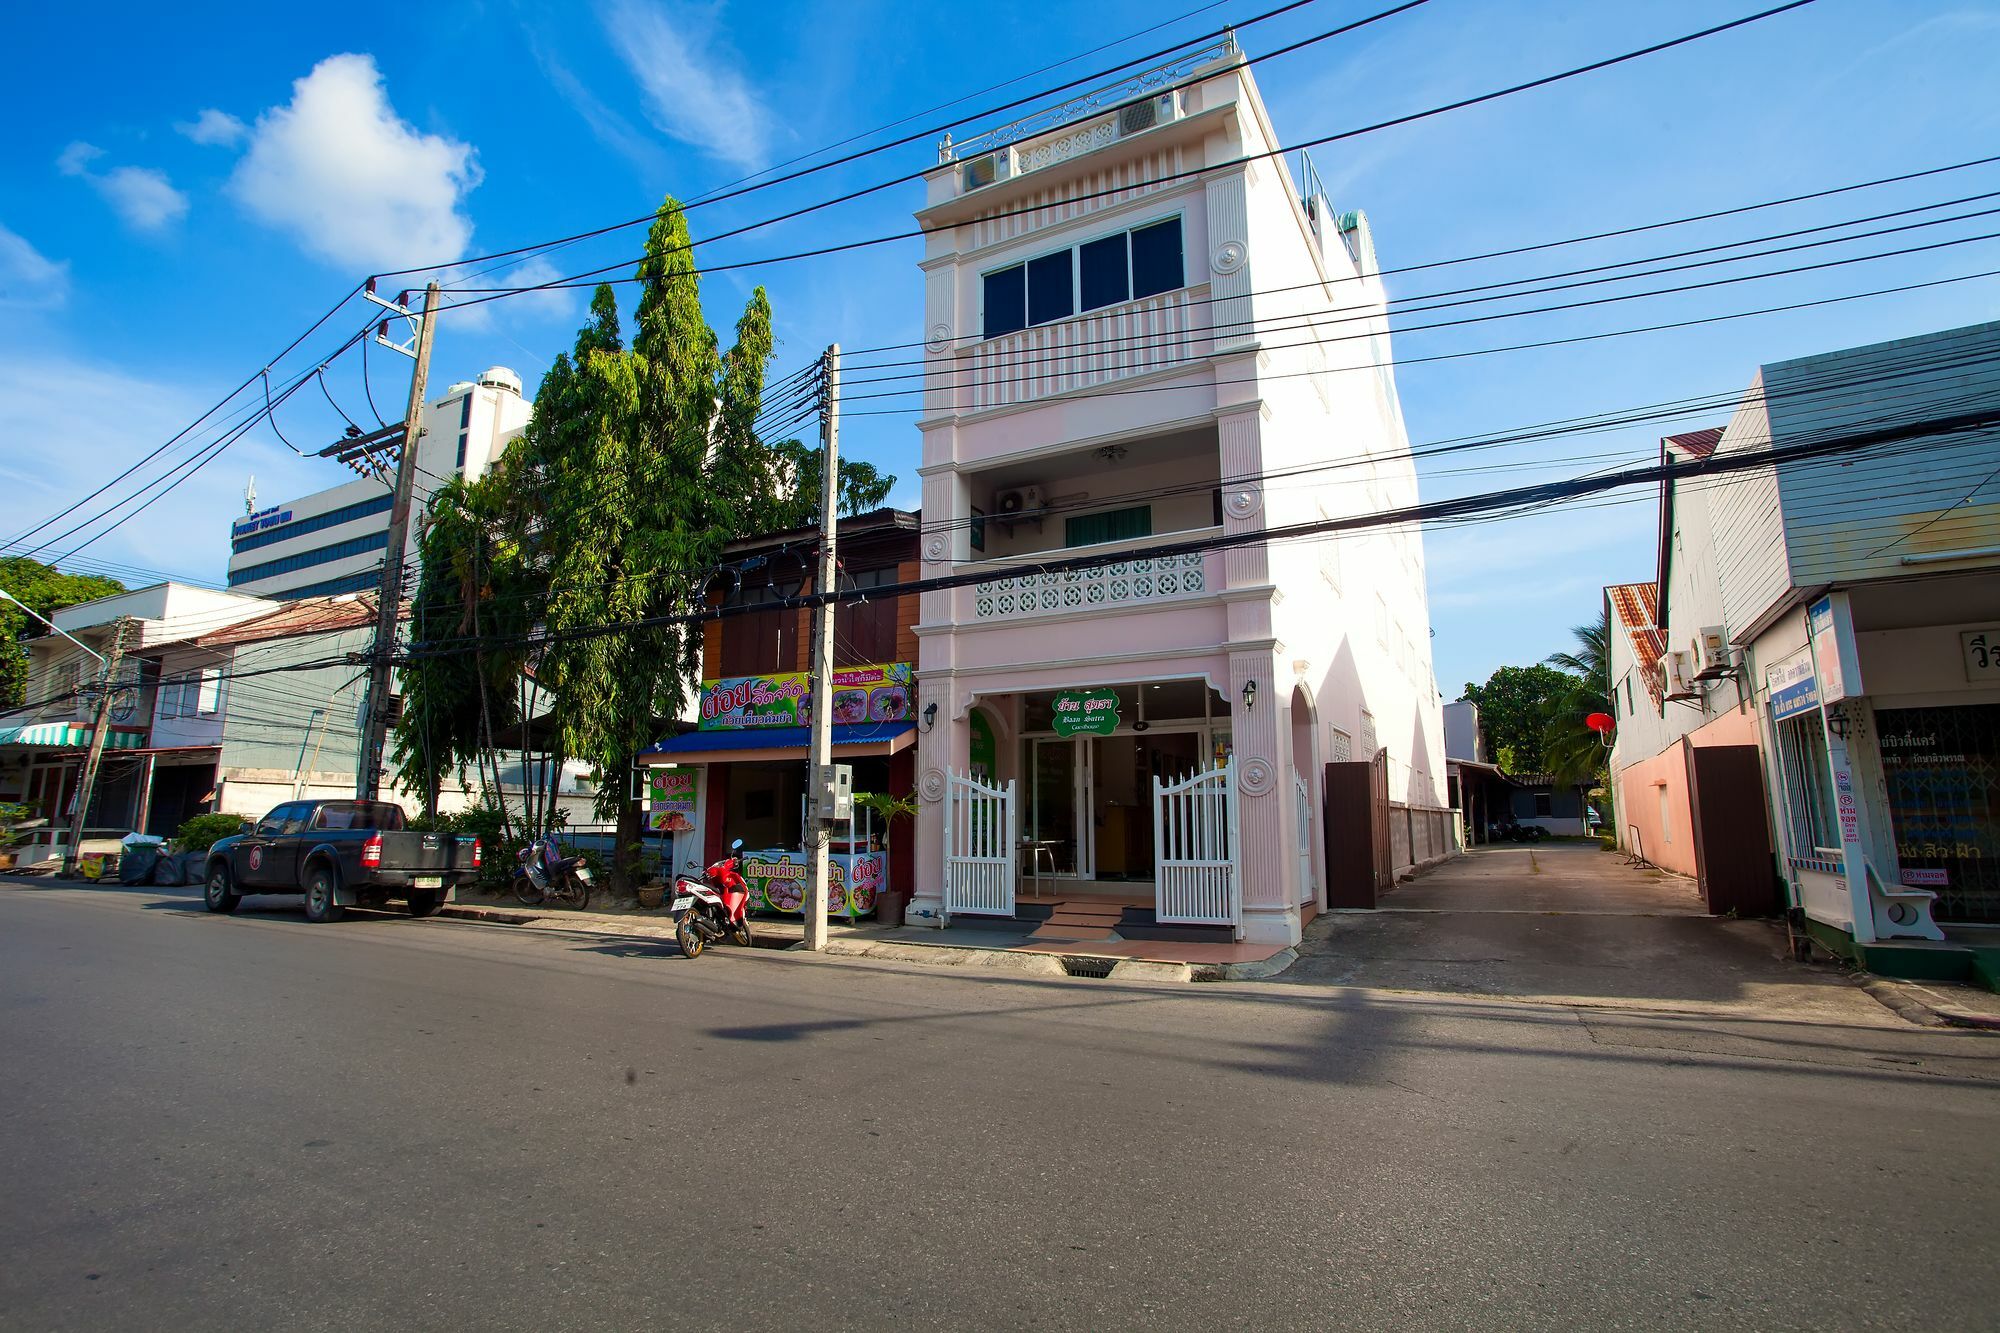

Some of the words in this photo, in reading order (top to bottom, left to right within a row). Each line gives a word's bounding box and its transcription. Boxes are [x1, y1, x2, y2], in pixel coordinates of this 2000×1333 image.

[1880, 729, 1937, 748] ย์บิวตี้แคร์
